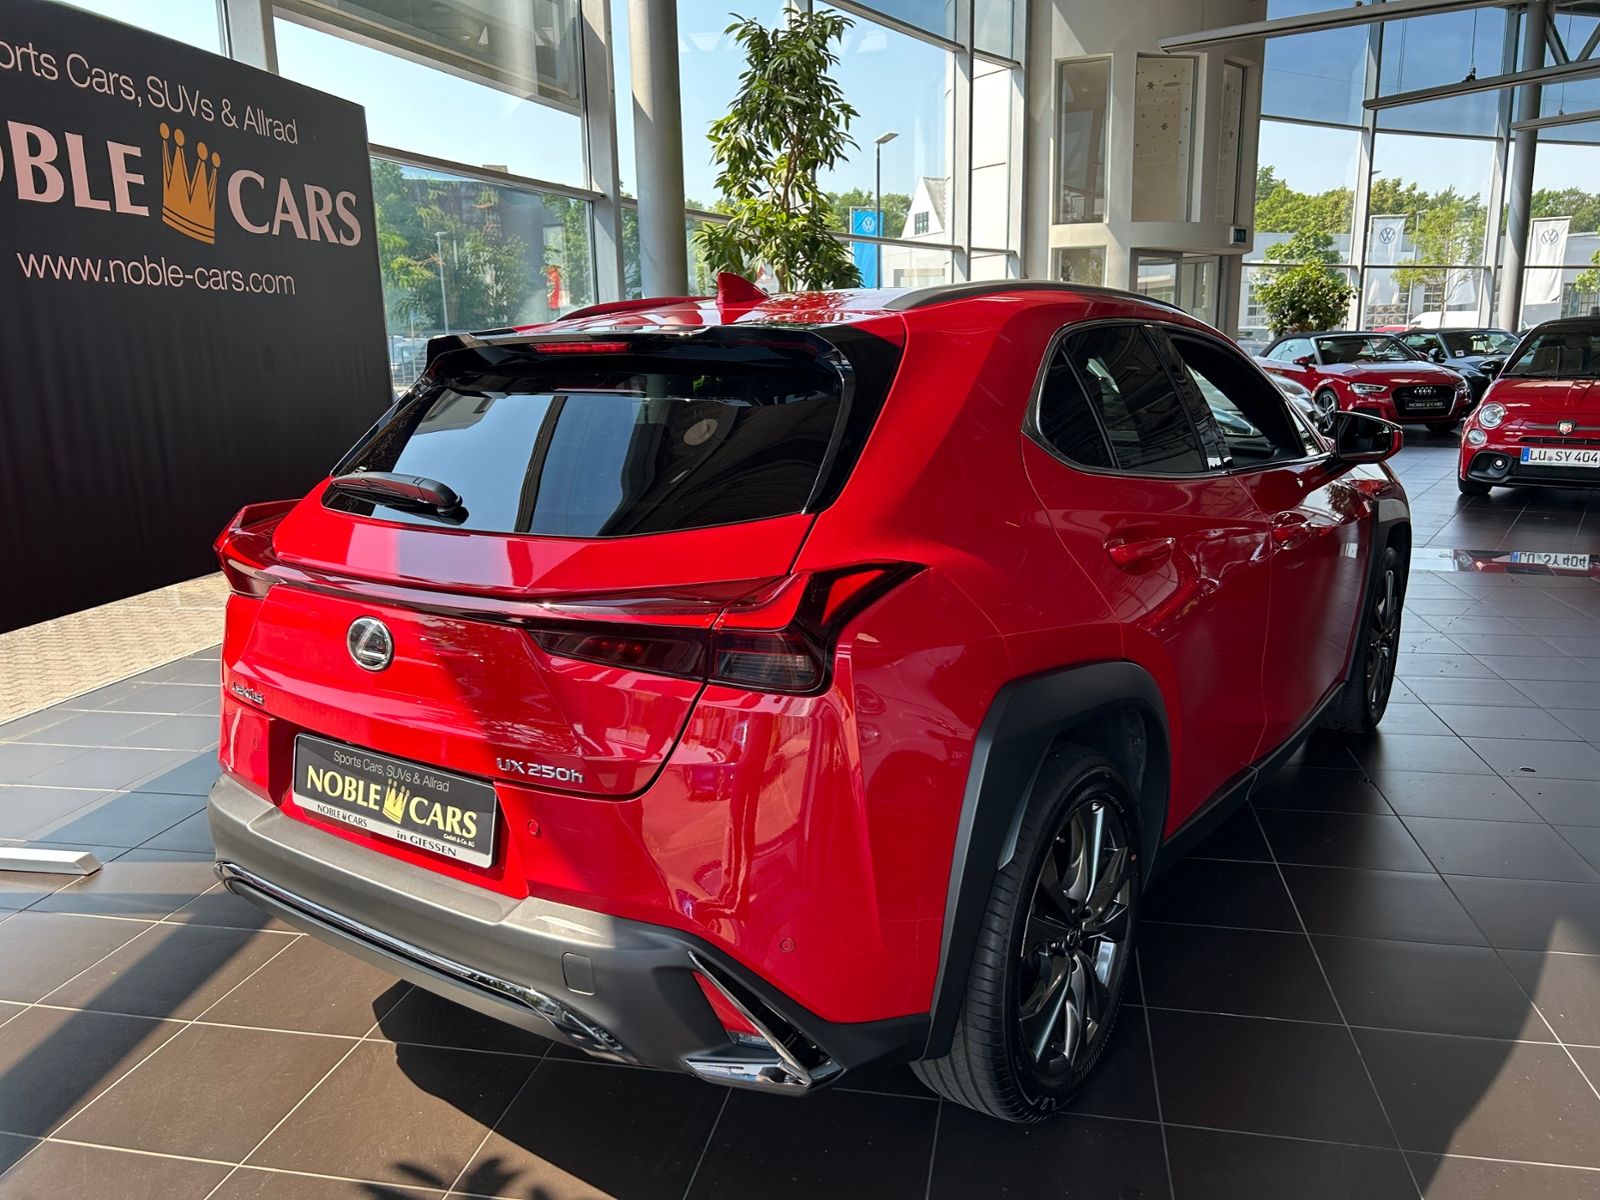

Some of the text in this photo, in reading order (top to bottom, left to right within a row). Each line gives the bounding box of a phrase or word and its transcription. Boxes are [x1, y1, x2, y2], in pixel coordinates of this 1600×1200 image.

[66, 53, 142, 107] Cars,
[146, 75, 215, 122] SUVs
[221, 98, 239, 129] &
[243, 105, 299, 145] Allrad
[0, 119, 362, 247] BLE CARS
[16, 252, 296, 295] www.noble-cars.com
[1530, 450, 1599, 464] LU SY 404
[333, 750, 450, 793] Sports Cars, SUVs & Allrad
[496, 757, 584, 784] UX 250h
[306, 764, 478, 839] NOBLE CARS
[317, 803, 368, 828] NOBLE CARS
[396, 830, 457, 857] in GIESSEN
